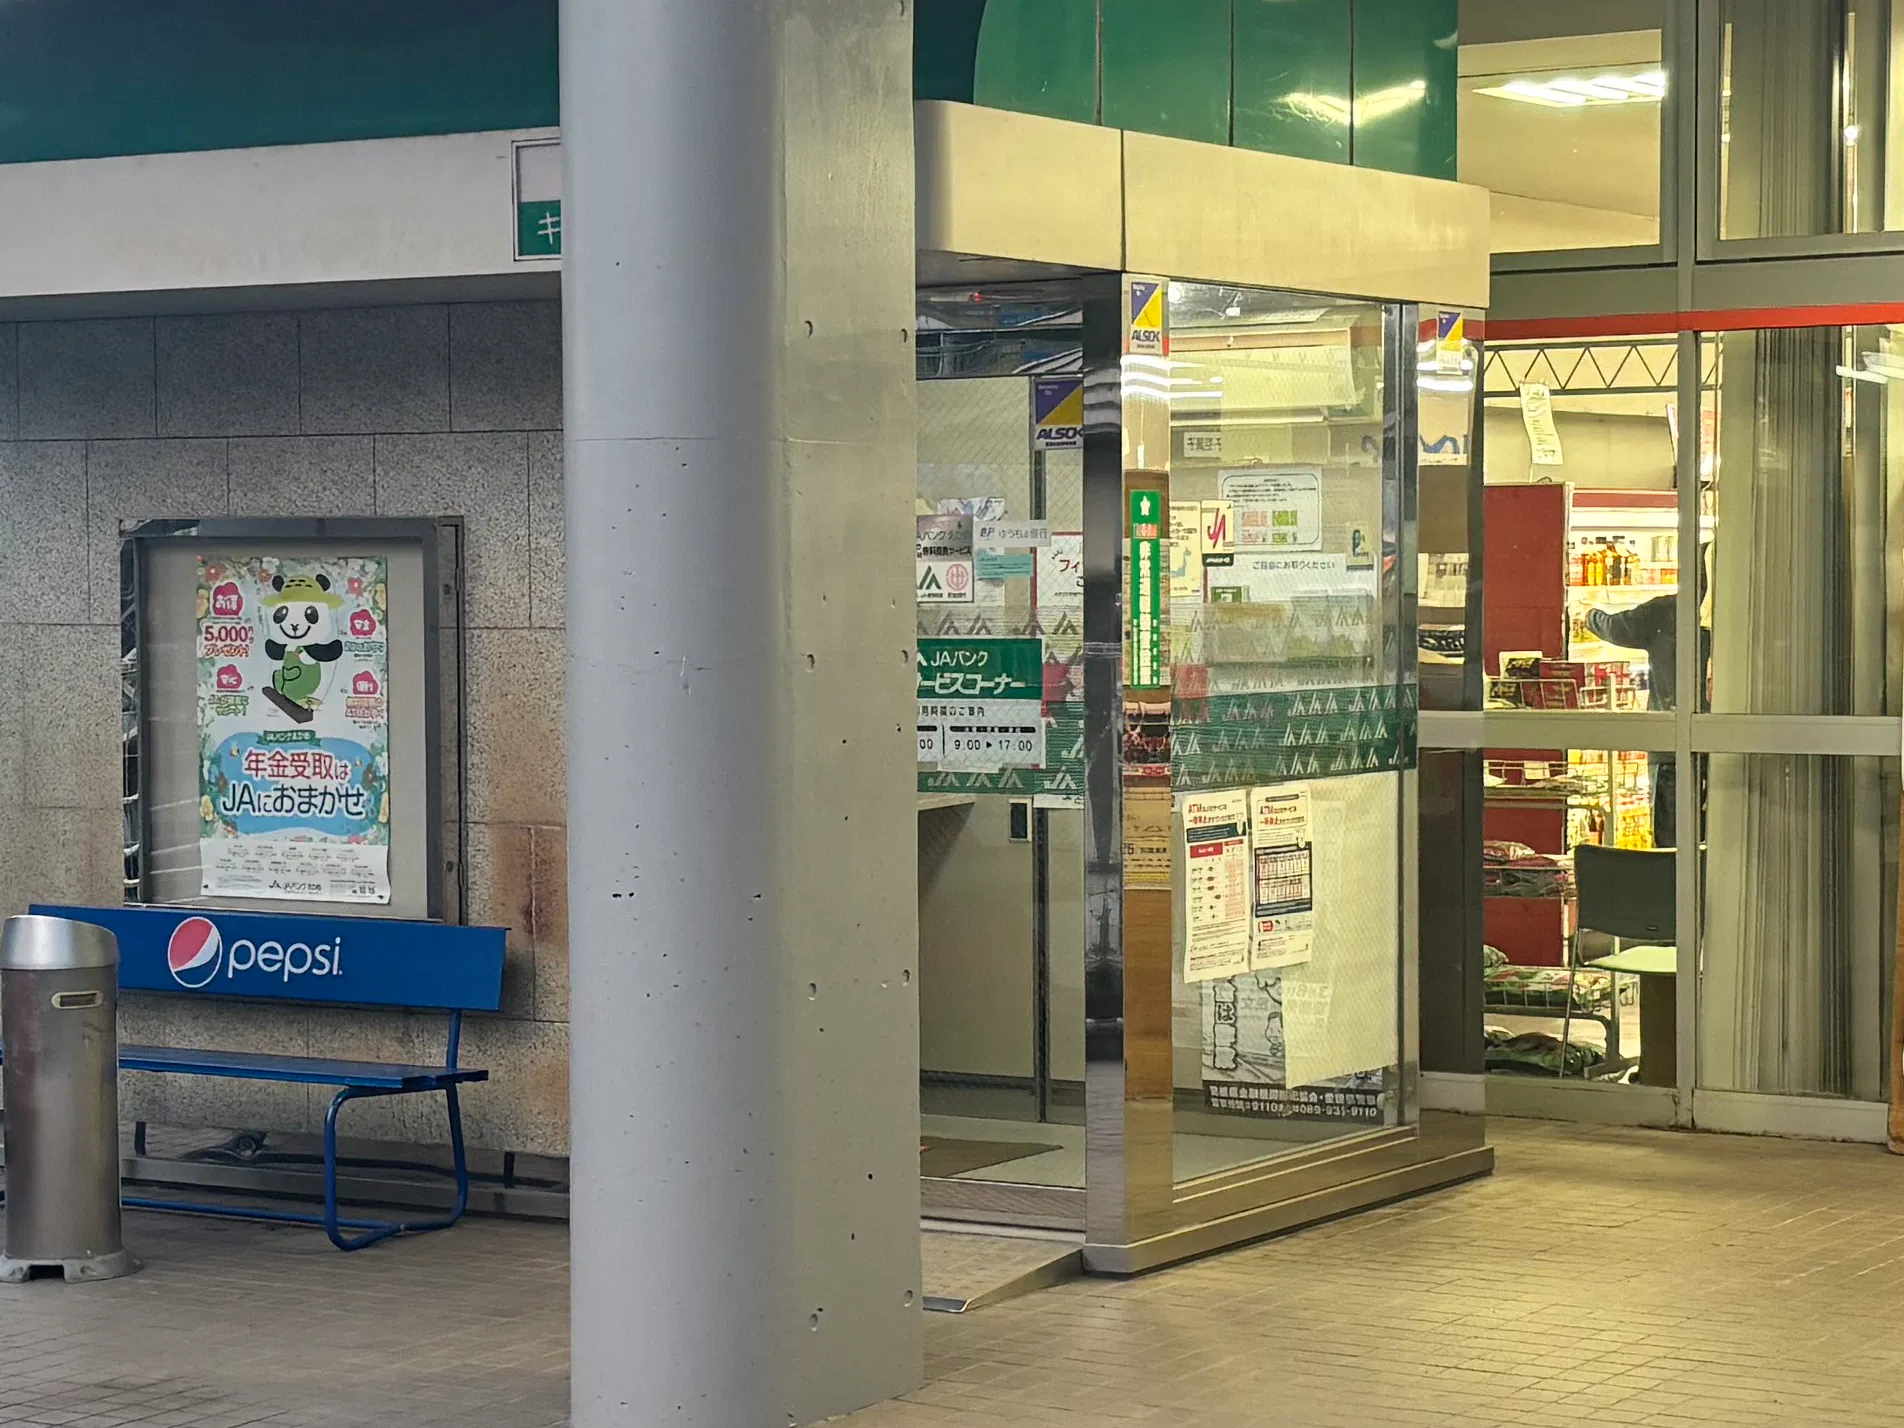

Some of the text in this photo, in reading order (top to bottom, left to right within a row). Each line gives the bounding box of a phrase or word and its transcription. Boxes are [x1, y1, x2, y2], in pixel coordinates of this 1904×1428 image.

[1036, 426, 1084, 441] ALSOK
[930, 651, 988, 667] JAバンク
[917, 671, 1026, 695] ービスコーナー
[998, 739, 1033, 752] 17:00
[244, 749, 349, 781] 年金受取は
[222, 783, 365, 817] JAにおまかせ
[227, 936, 341, 983] pepsi
